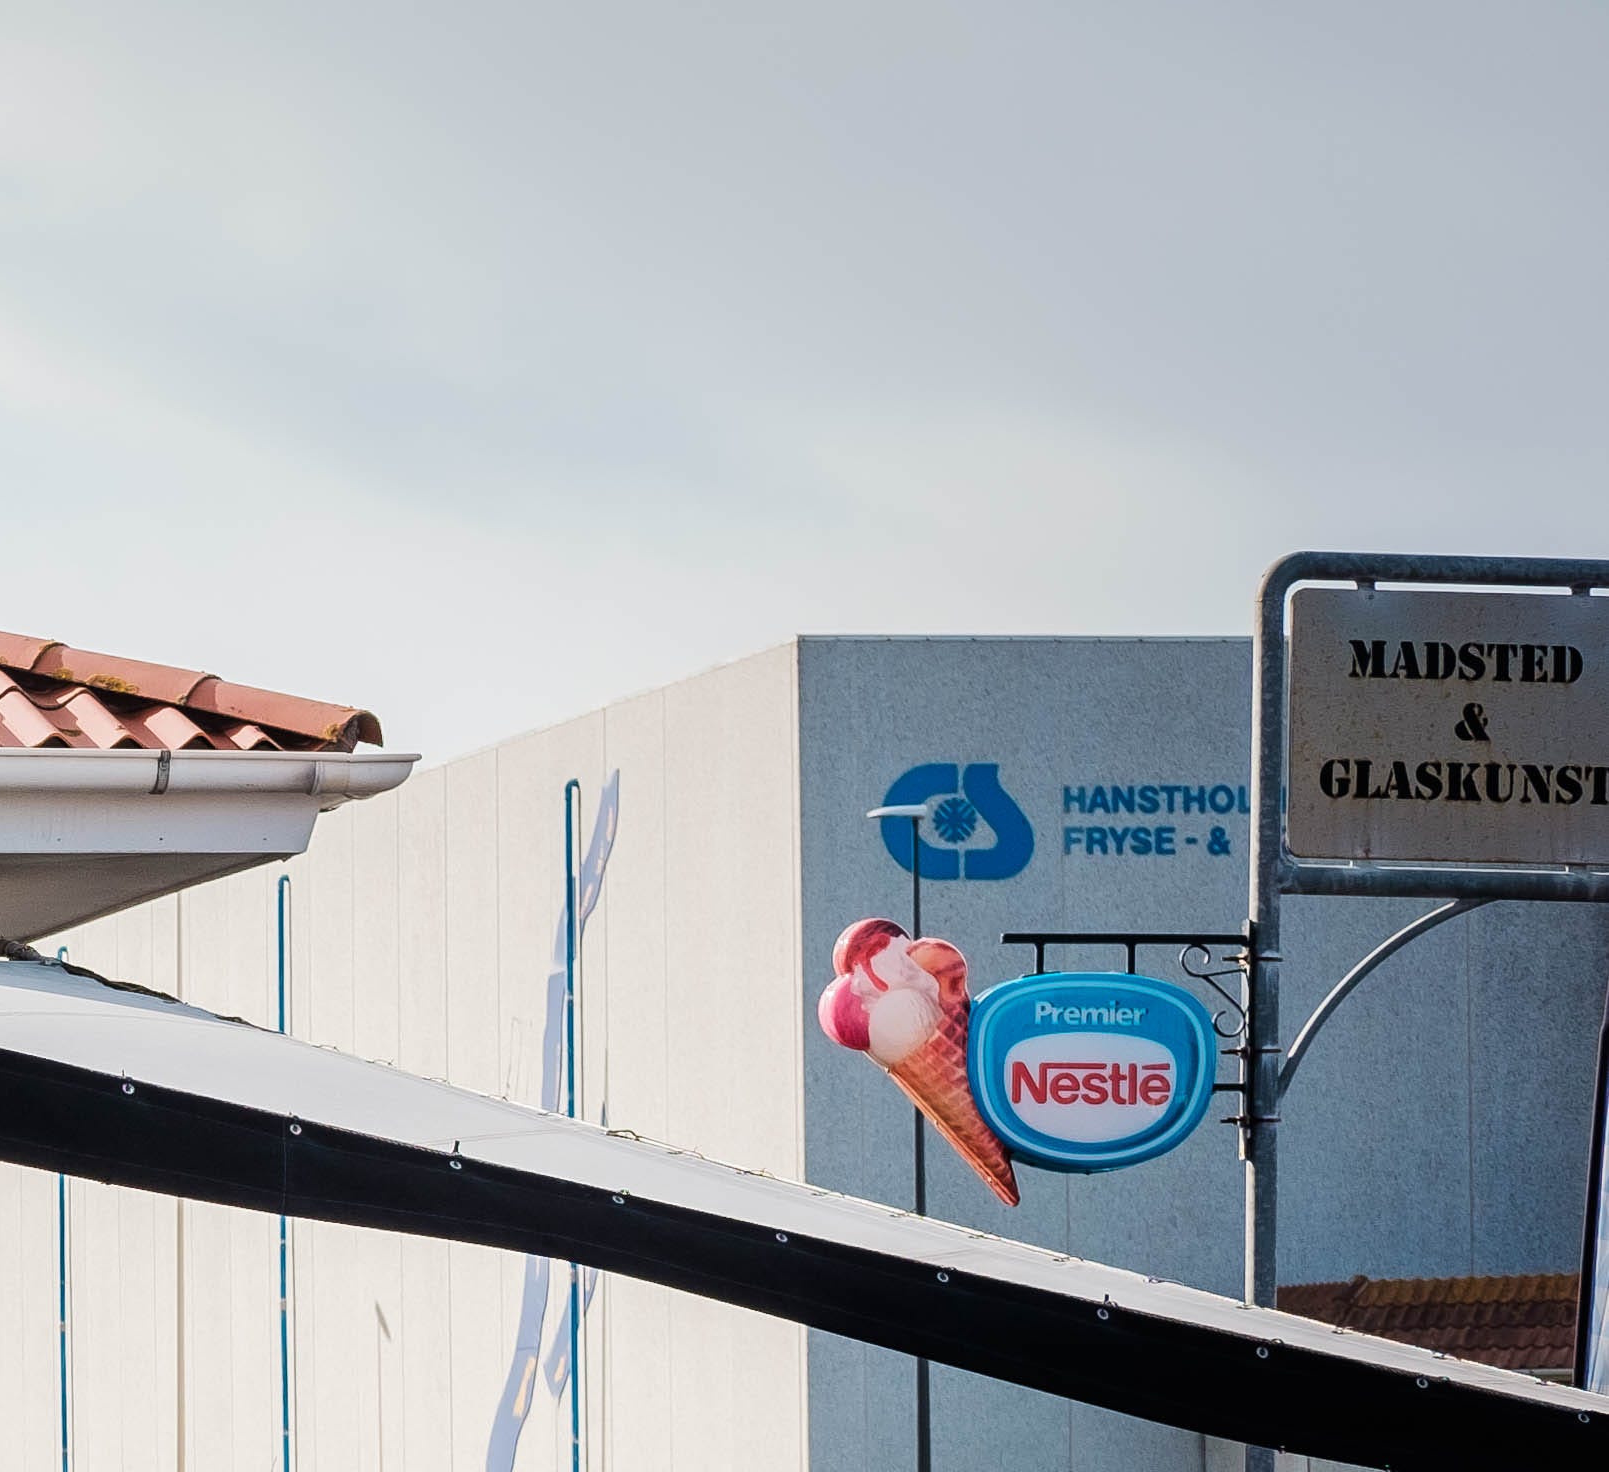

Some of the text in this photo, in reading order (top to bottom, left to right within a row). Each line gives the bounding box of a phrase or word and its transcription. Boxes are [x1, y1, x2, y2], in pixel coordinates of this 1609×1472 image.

[1348, 639, 1584, 684] MADSTED
[1453, 702, 1491, 742] &
[1063, 784, 1250, 814] HANSTHOL
[1319, 758, 1609, 806] GLASKUNST
[1064, 826, 1177, 855] FRYSE
[1206, 825, 1231, 856] &
[1034, 1000, 1148, 1026] Premier
[1011, 1060, 1171, 1106] Nestlé
